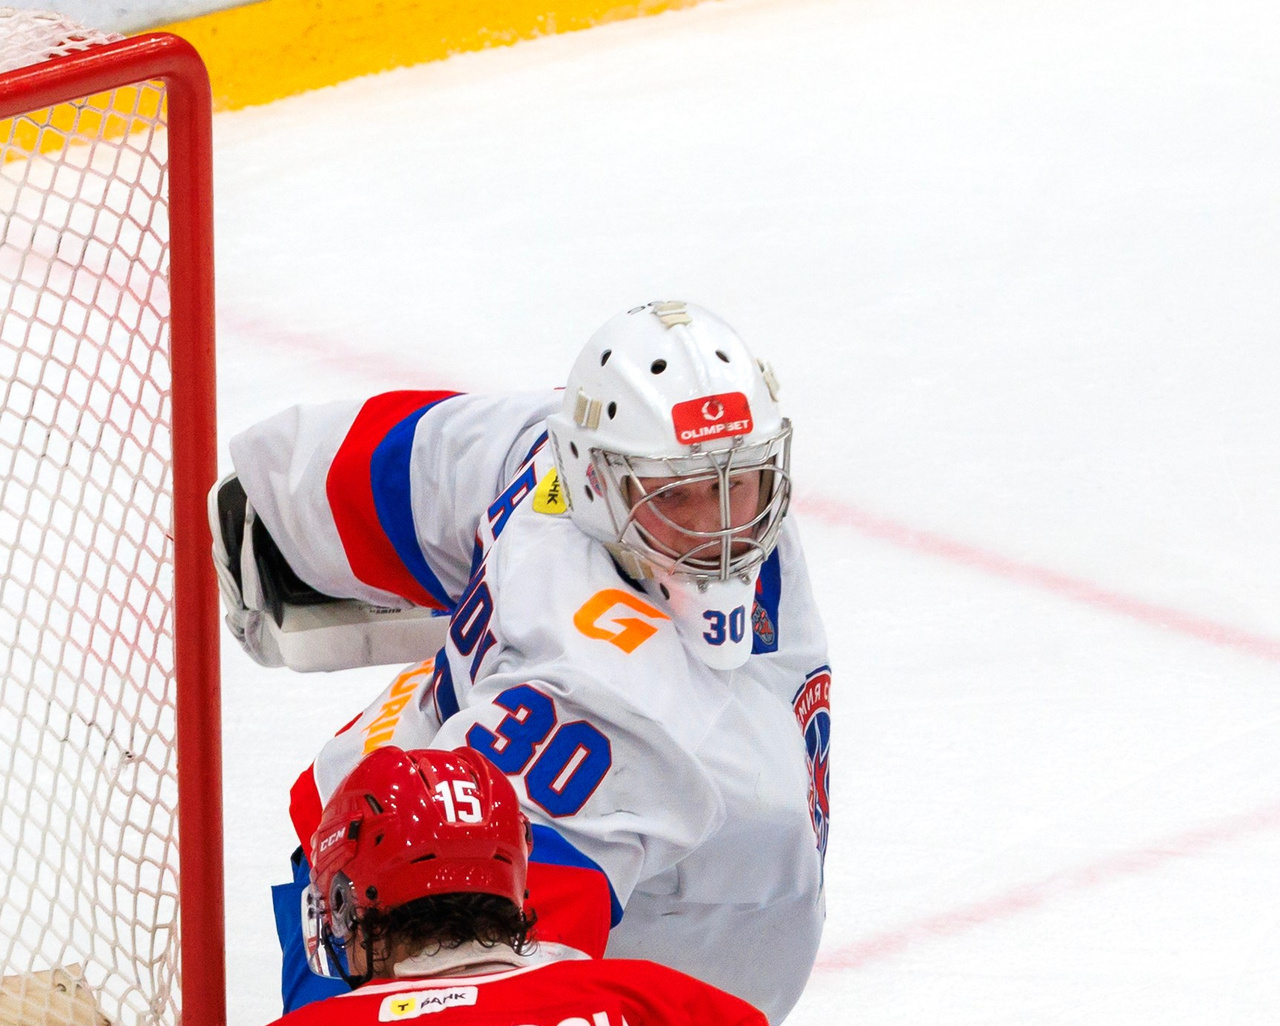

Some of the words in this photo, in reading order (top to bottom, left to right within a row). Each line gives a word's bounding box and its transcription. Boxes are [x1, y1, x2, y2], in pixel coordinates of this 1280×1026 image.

[680, 419, 750, 440] OLIMPBET
[702, 604, 746, 647] 30
[465, 683, 613, 818] 30
[434, 780, 484, 824] 15
[320, 827, 347, 853] CCM
